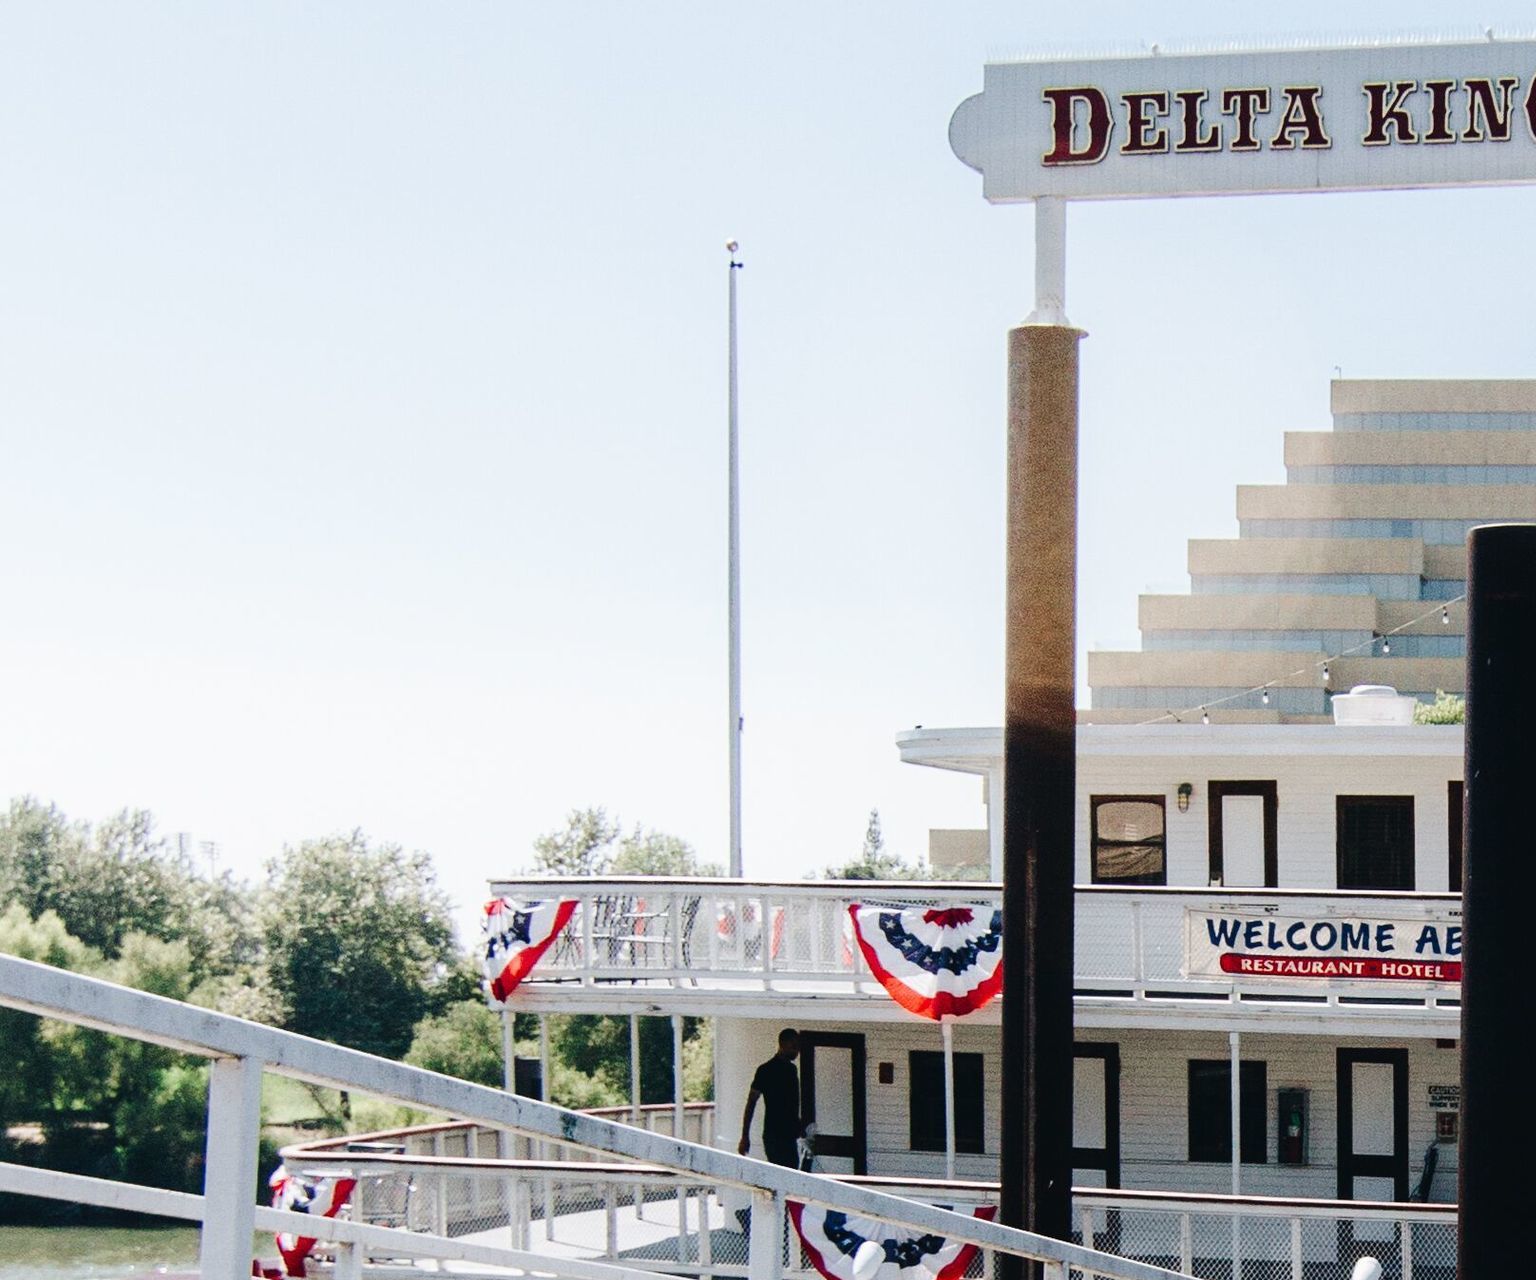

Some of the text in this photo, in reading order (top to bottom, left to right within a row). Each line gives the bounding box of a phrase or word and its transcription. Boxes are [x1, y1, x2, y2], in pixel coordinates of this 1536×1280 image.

[1041, 85, 1332, 166] DELTA
[1206, 918, 1395, 952] WELCOME
[1240, 958, 1444, 978] RESTAURANT HOTEL
